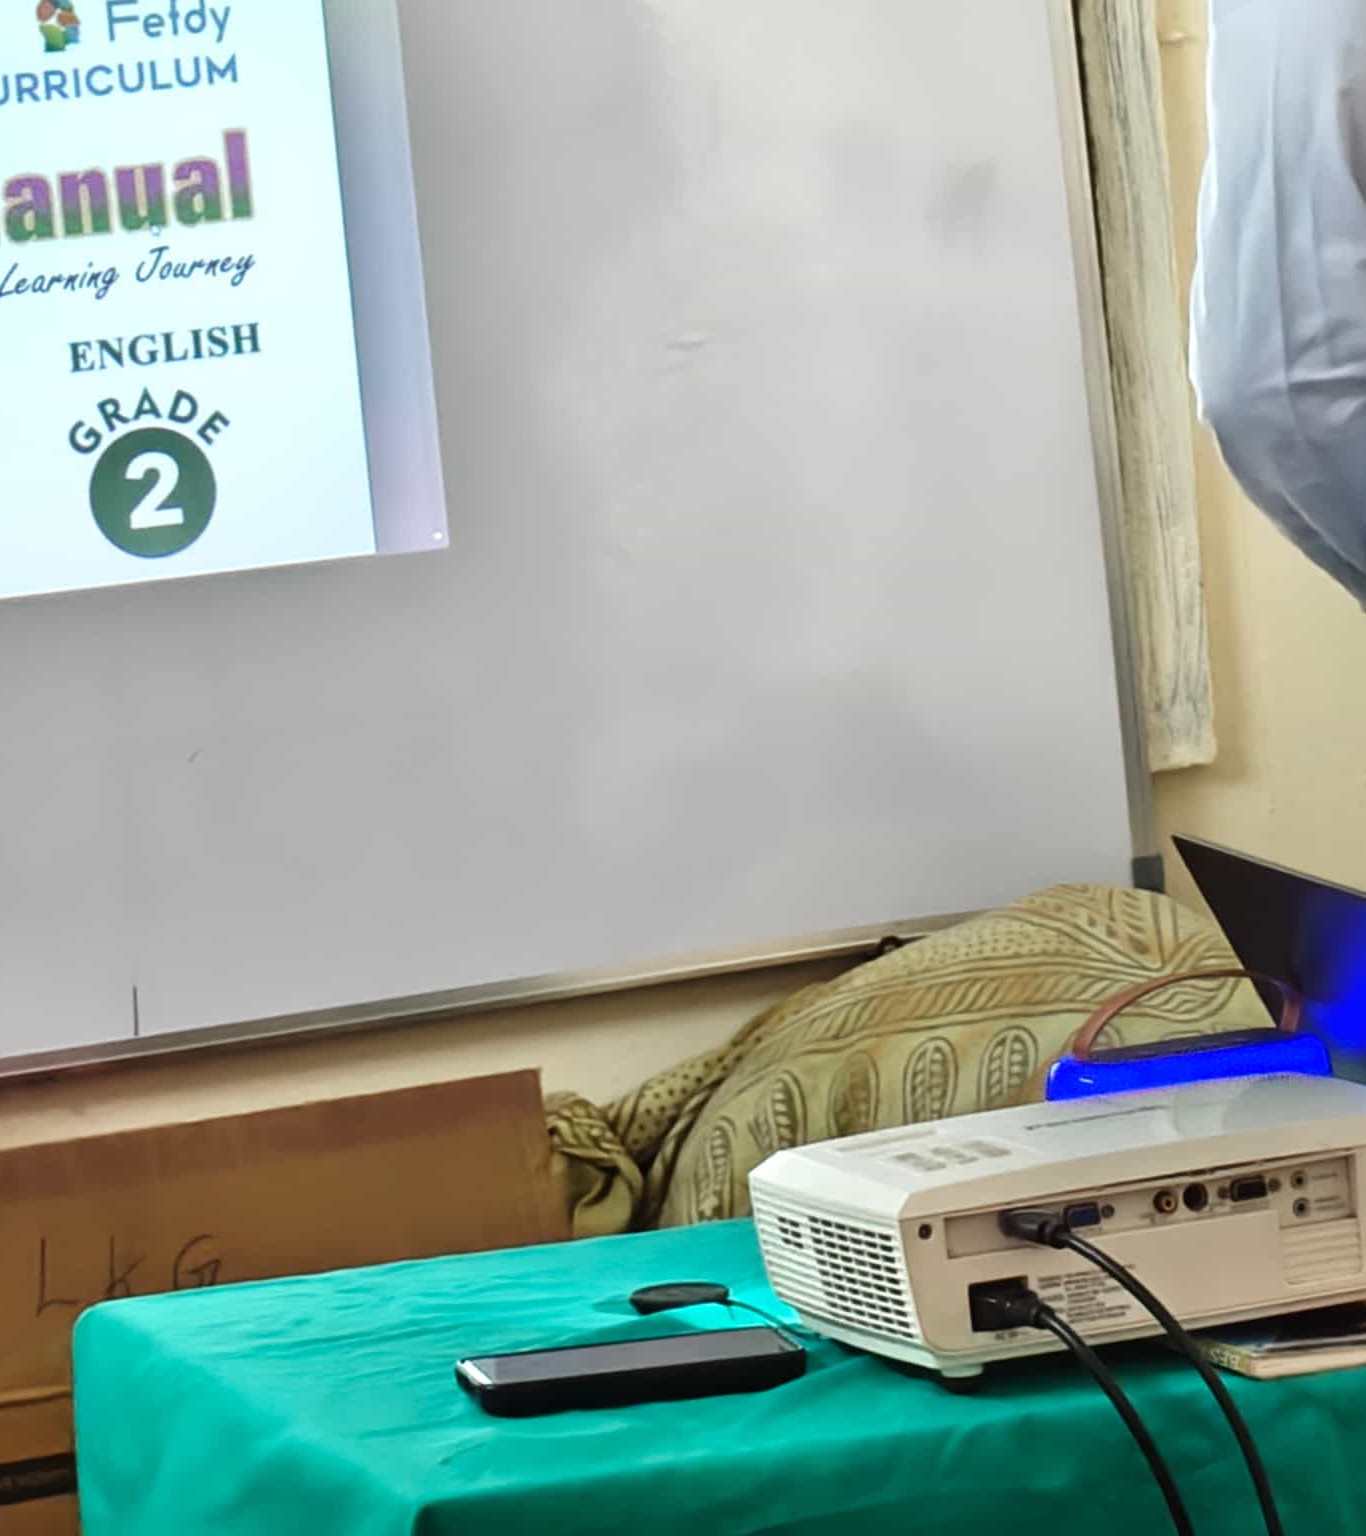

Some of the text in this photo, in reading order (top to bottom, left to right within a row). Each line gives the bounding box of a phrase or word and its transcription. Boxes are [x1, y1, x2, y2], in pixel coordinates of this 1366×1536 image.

[135, 245, 256, 286] Journey
[68, 321, 261, 373] ENGLISH
[68, 386, 231, 455] GRADE
[125, 450, 184, 530] 2
